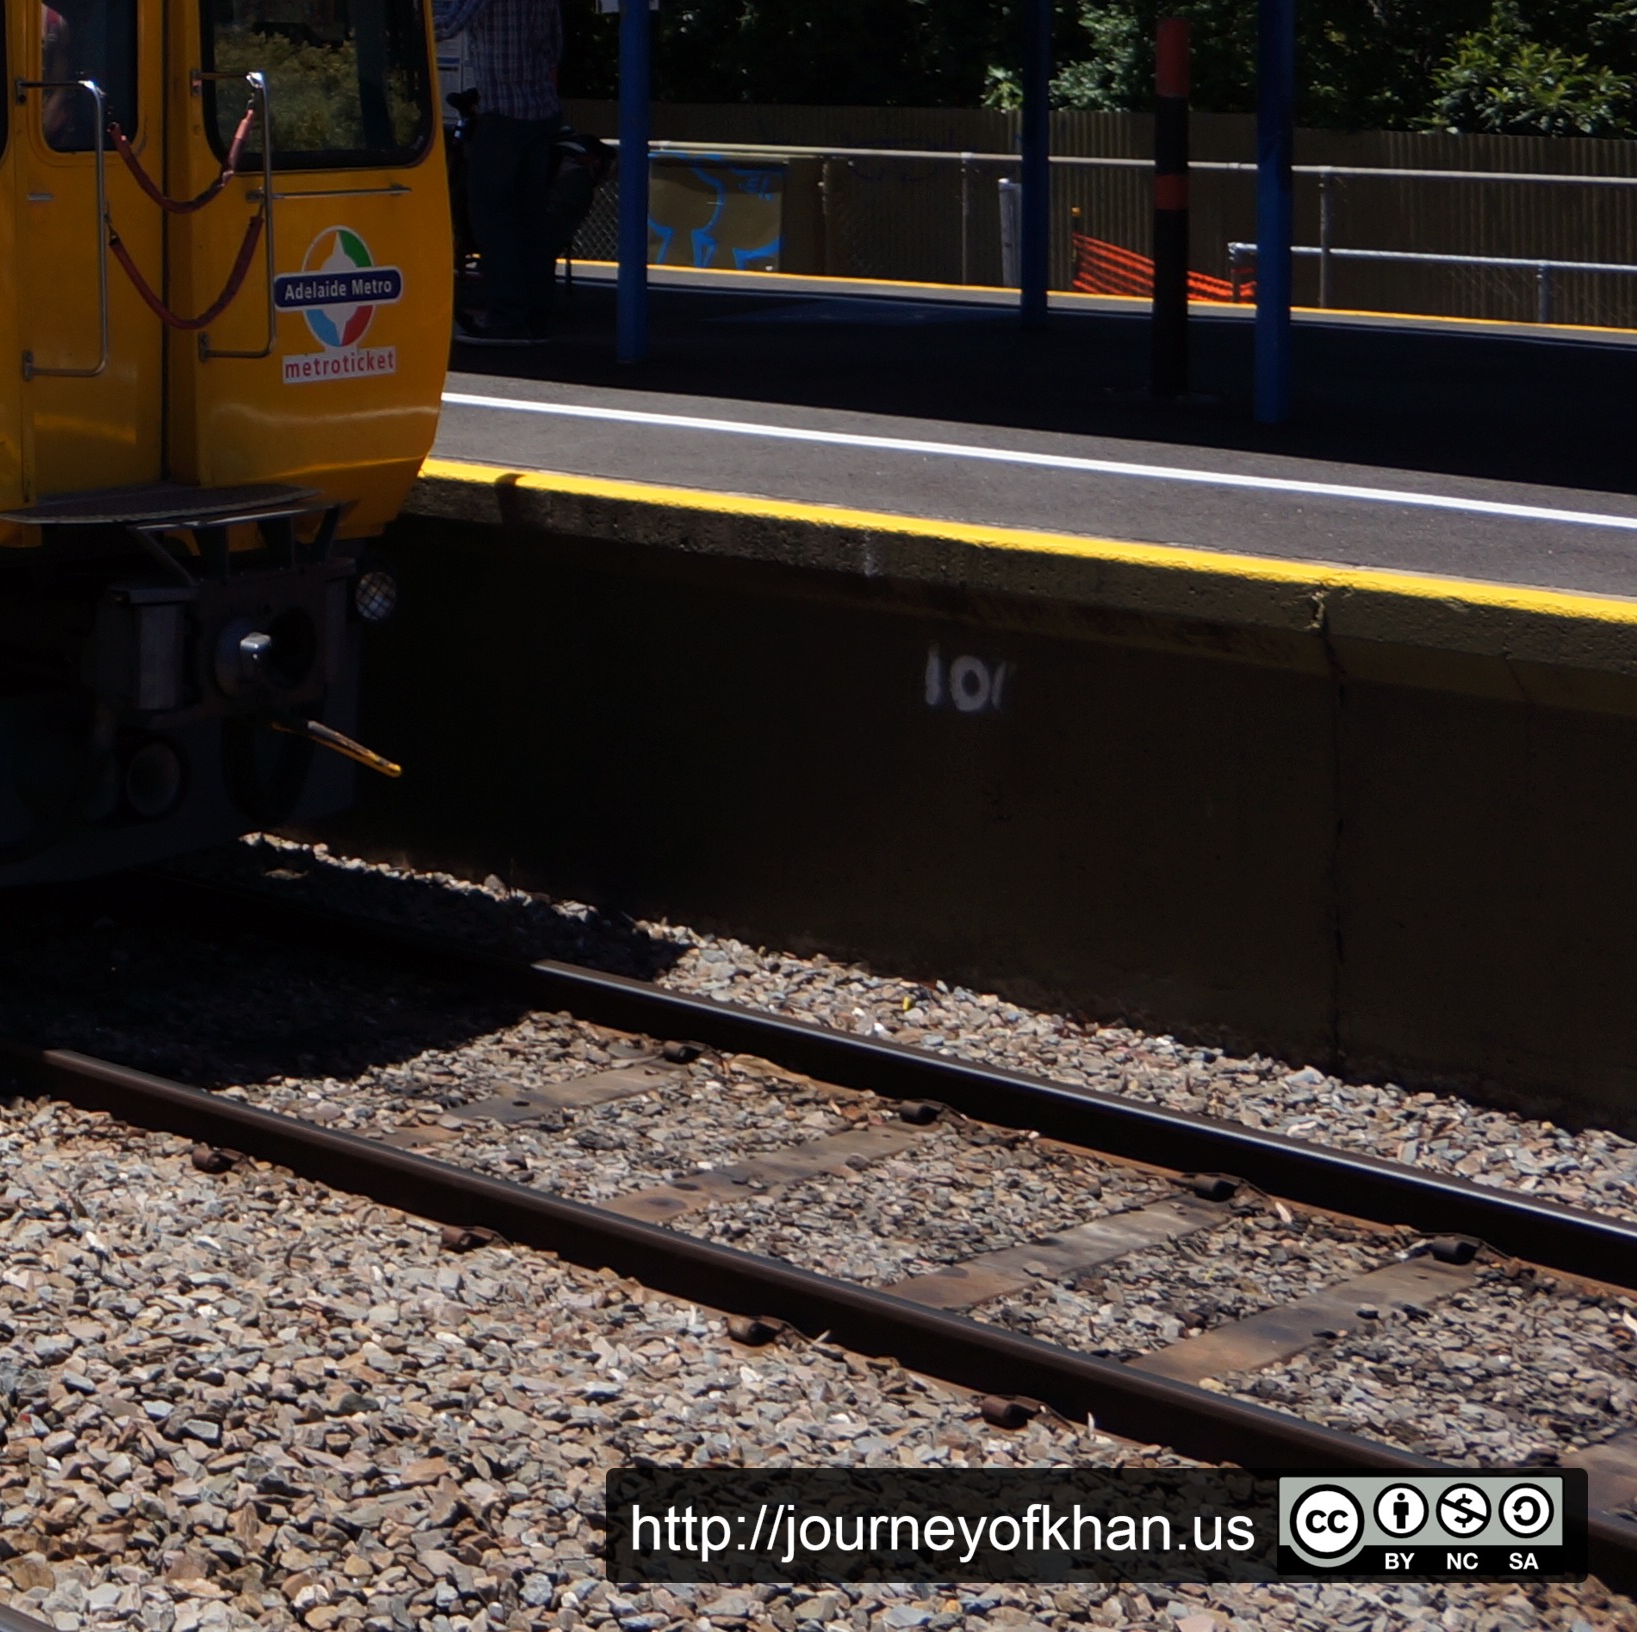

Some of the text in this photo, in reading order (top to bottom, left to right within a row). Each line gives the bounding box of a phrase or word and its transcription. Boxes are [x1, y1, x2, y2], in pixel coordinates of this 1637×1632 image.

[284, 278, 393, 301] Adelaide Metro
[284, 350, 394, 379] metroticket
